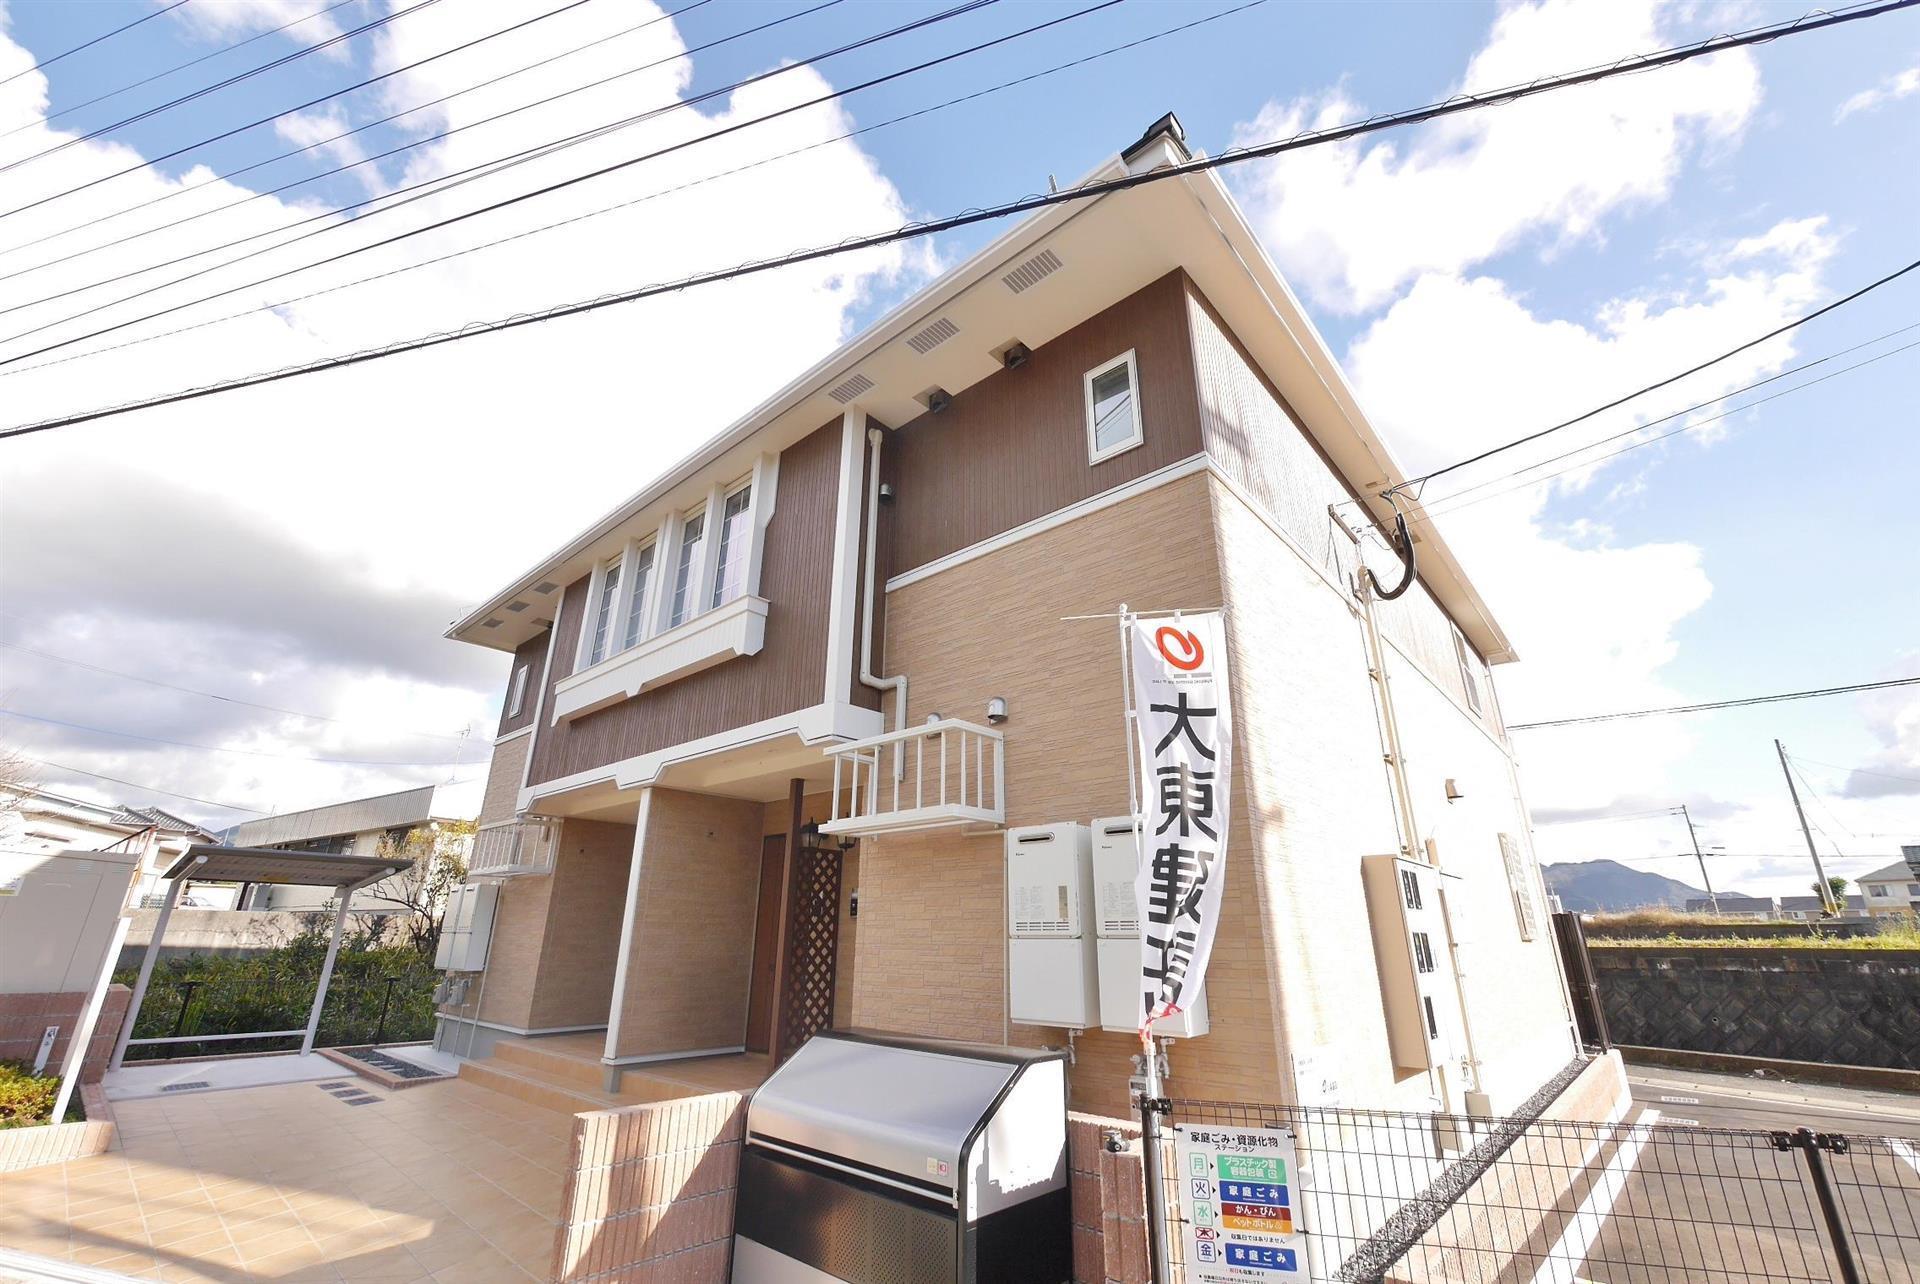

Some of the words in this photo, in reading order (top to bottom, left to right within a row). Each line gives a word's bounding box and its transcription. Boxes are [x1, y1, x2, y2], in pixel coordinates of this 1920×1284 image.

[1190, 1131, 1279, 1148] 家庭ごみ・資源化物
[1215, 1144, 1255, 1153] ステーション
[1194, 1157, 1204, 1170] 月
[1225, 1156, 1277, 1169] プラスチック製
[1195, 1182, 1206, 1194] 火
[1229, 1185, 1279, 1199] 家庭ごみ
[1198, 1205, 1208, 1218] 水
[1235, 1205, 1276, 1216] かん・びん
[1233, 1218, 1273, 1229] ペットボトル
[1231, 1233, 1285, 1244] 収集日ではありません
[1201, 1244, 1212, 1257] 金
[1235, 1248, 1286, 1263] 家庭ごみ
